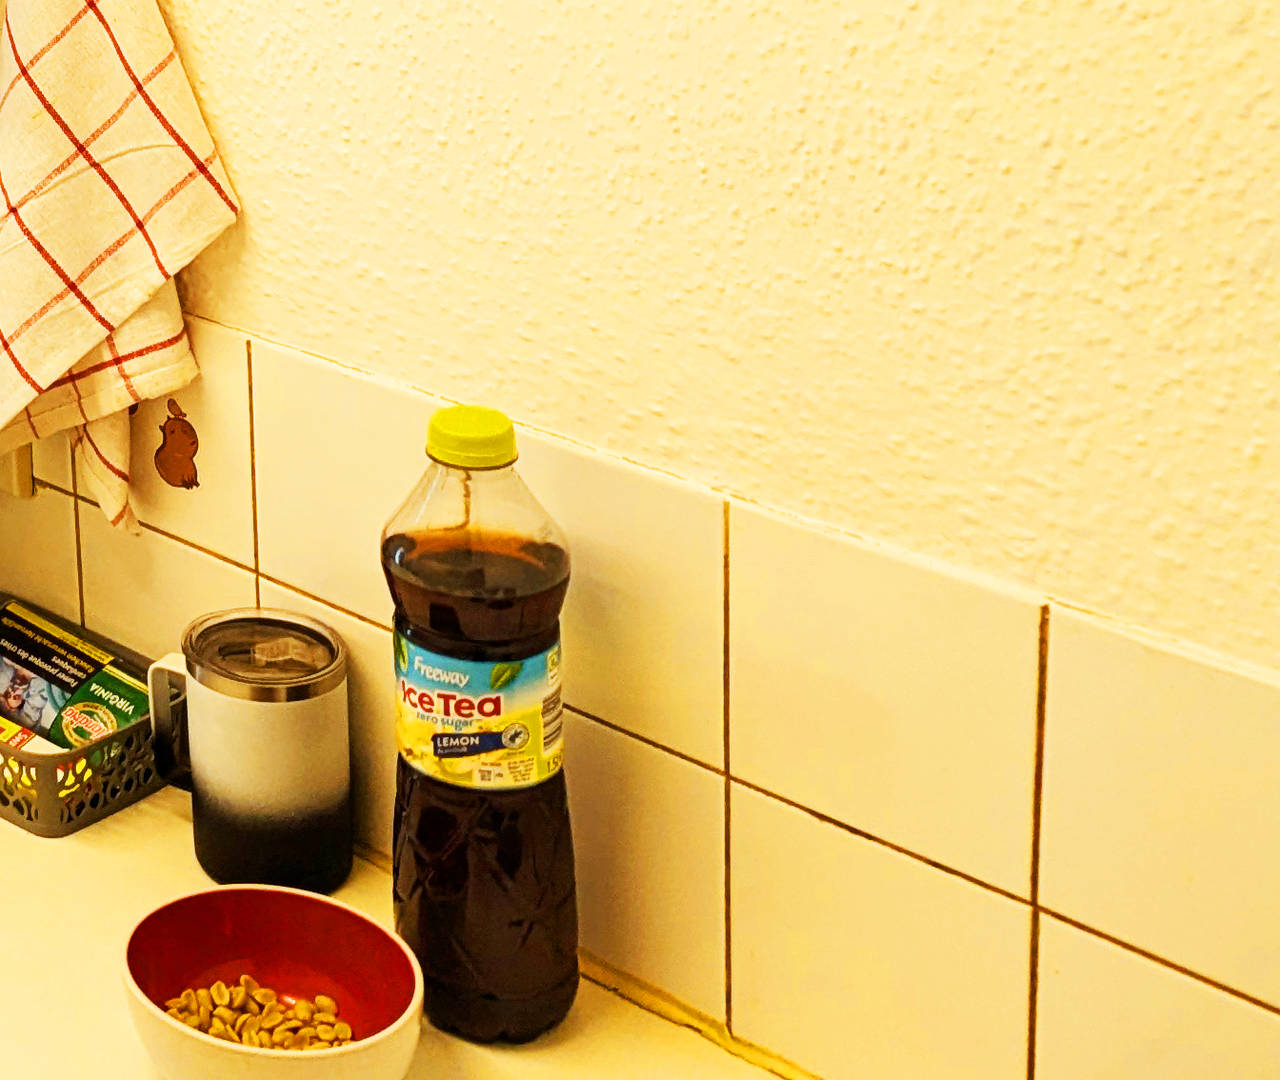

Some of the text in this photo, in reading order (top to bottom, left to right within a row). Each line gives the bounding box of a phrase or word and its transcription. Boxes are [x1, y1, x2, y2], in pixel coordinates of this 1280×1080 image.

[414, 656, 469, 688] Freeway
[90, 682, 135, 716] VIRGINIA
[441, 718, 474, 732] sugar
[437, 735, 480, 747] LEMON
